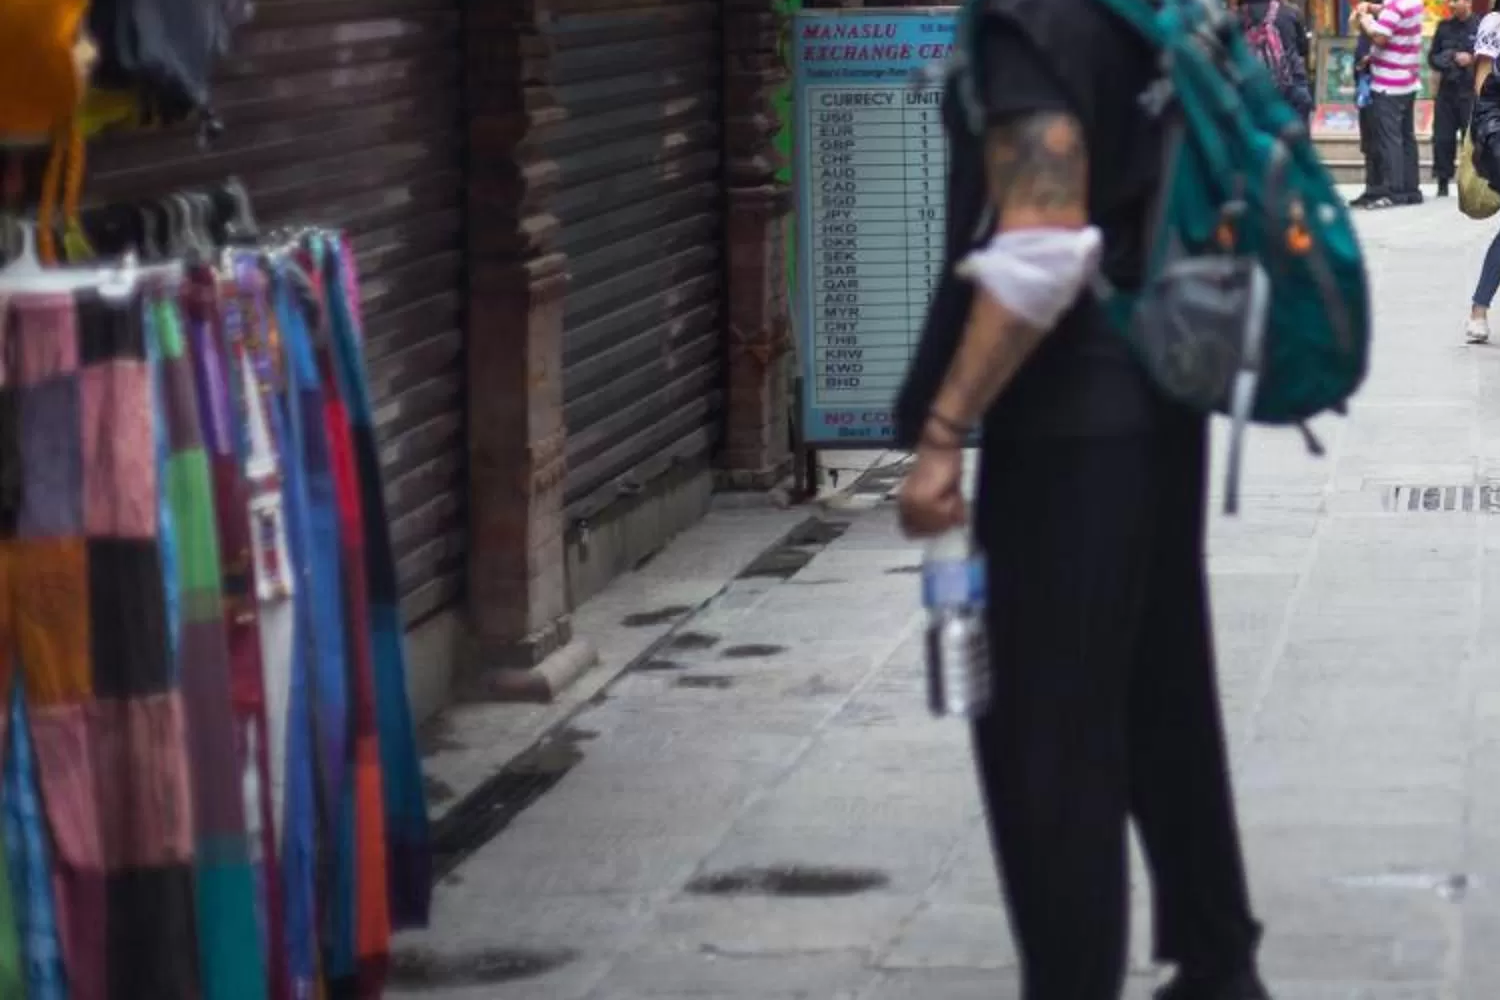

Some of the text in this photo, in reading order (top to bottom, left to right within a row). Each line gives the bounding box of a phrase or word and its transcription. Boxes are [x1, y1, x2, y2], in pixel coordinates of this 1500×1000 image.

[803, 23, 897, 40] MANASLU
[803, 43, 957, 62] EXCHANGE CEN
[820, 112, 853, 122] USD
[820, 126, 853, 136] EUR
[820, 154, 854, 164] CHF
[821, 168, 856, 178] AUD
[821, 182, 856, 192] CAD
[822, 209, 935, 219] JPY 10
[822, 223, 857, 233] HKD
[823, 251, 857, 261] SEK
[823, 265, 857, 275] SAR
[823, 279, 859, 289] QAR
[824, 308, 859, 318] MYR
[825, 322, 858, 332] CNY
[825, 336, 857, 345] THB
[825, 350, 862, 359] KRW
[825, 363, 863, 373] KWD
[826, 377, 860, 387] BHD
[825, 413, 856, 425] NO
